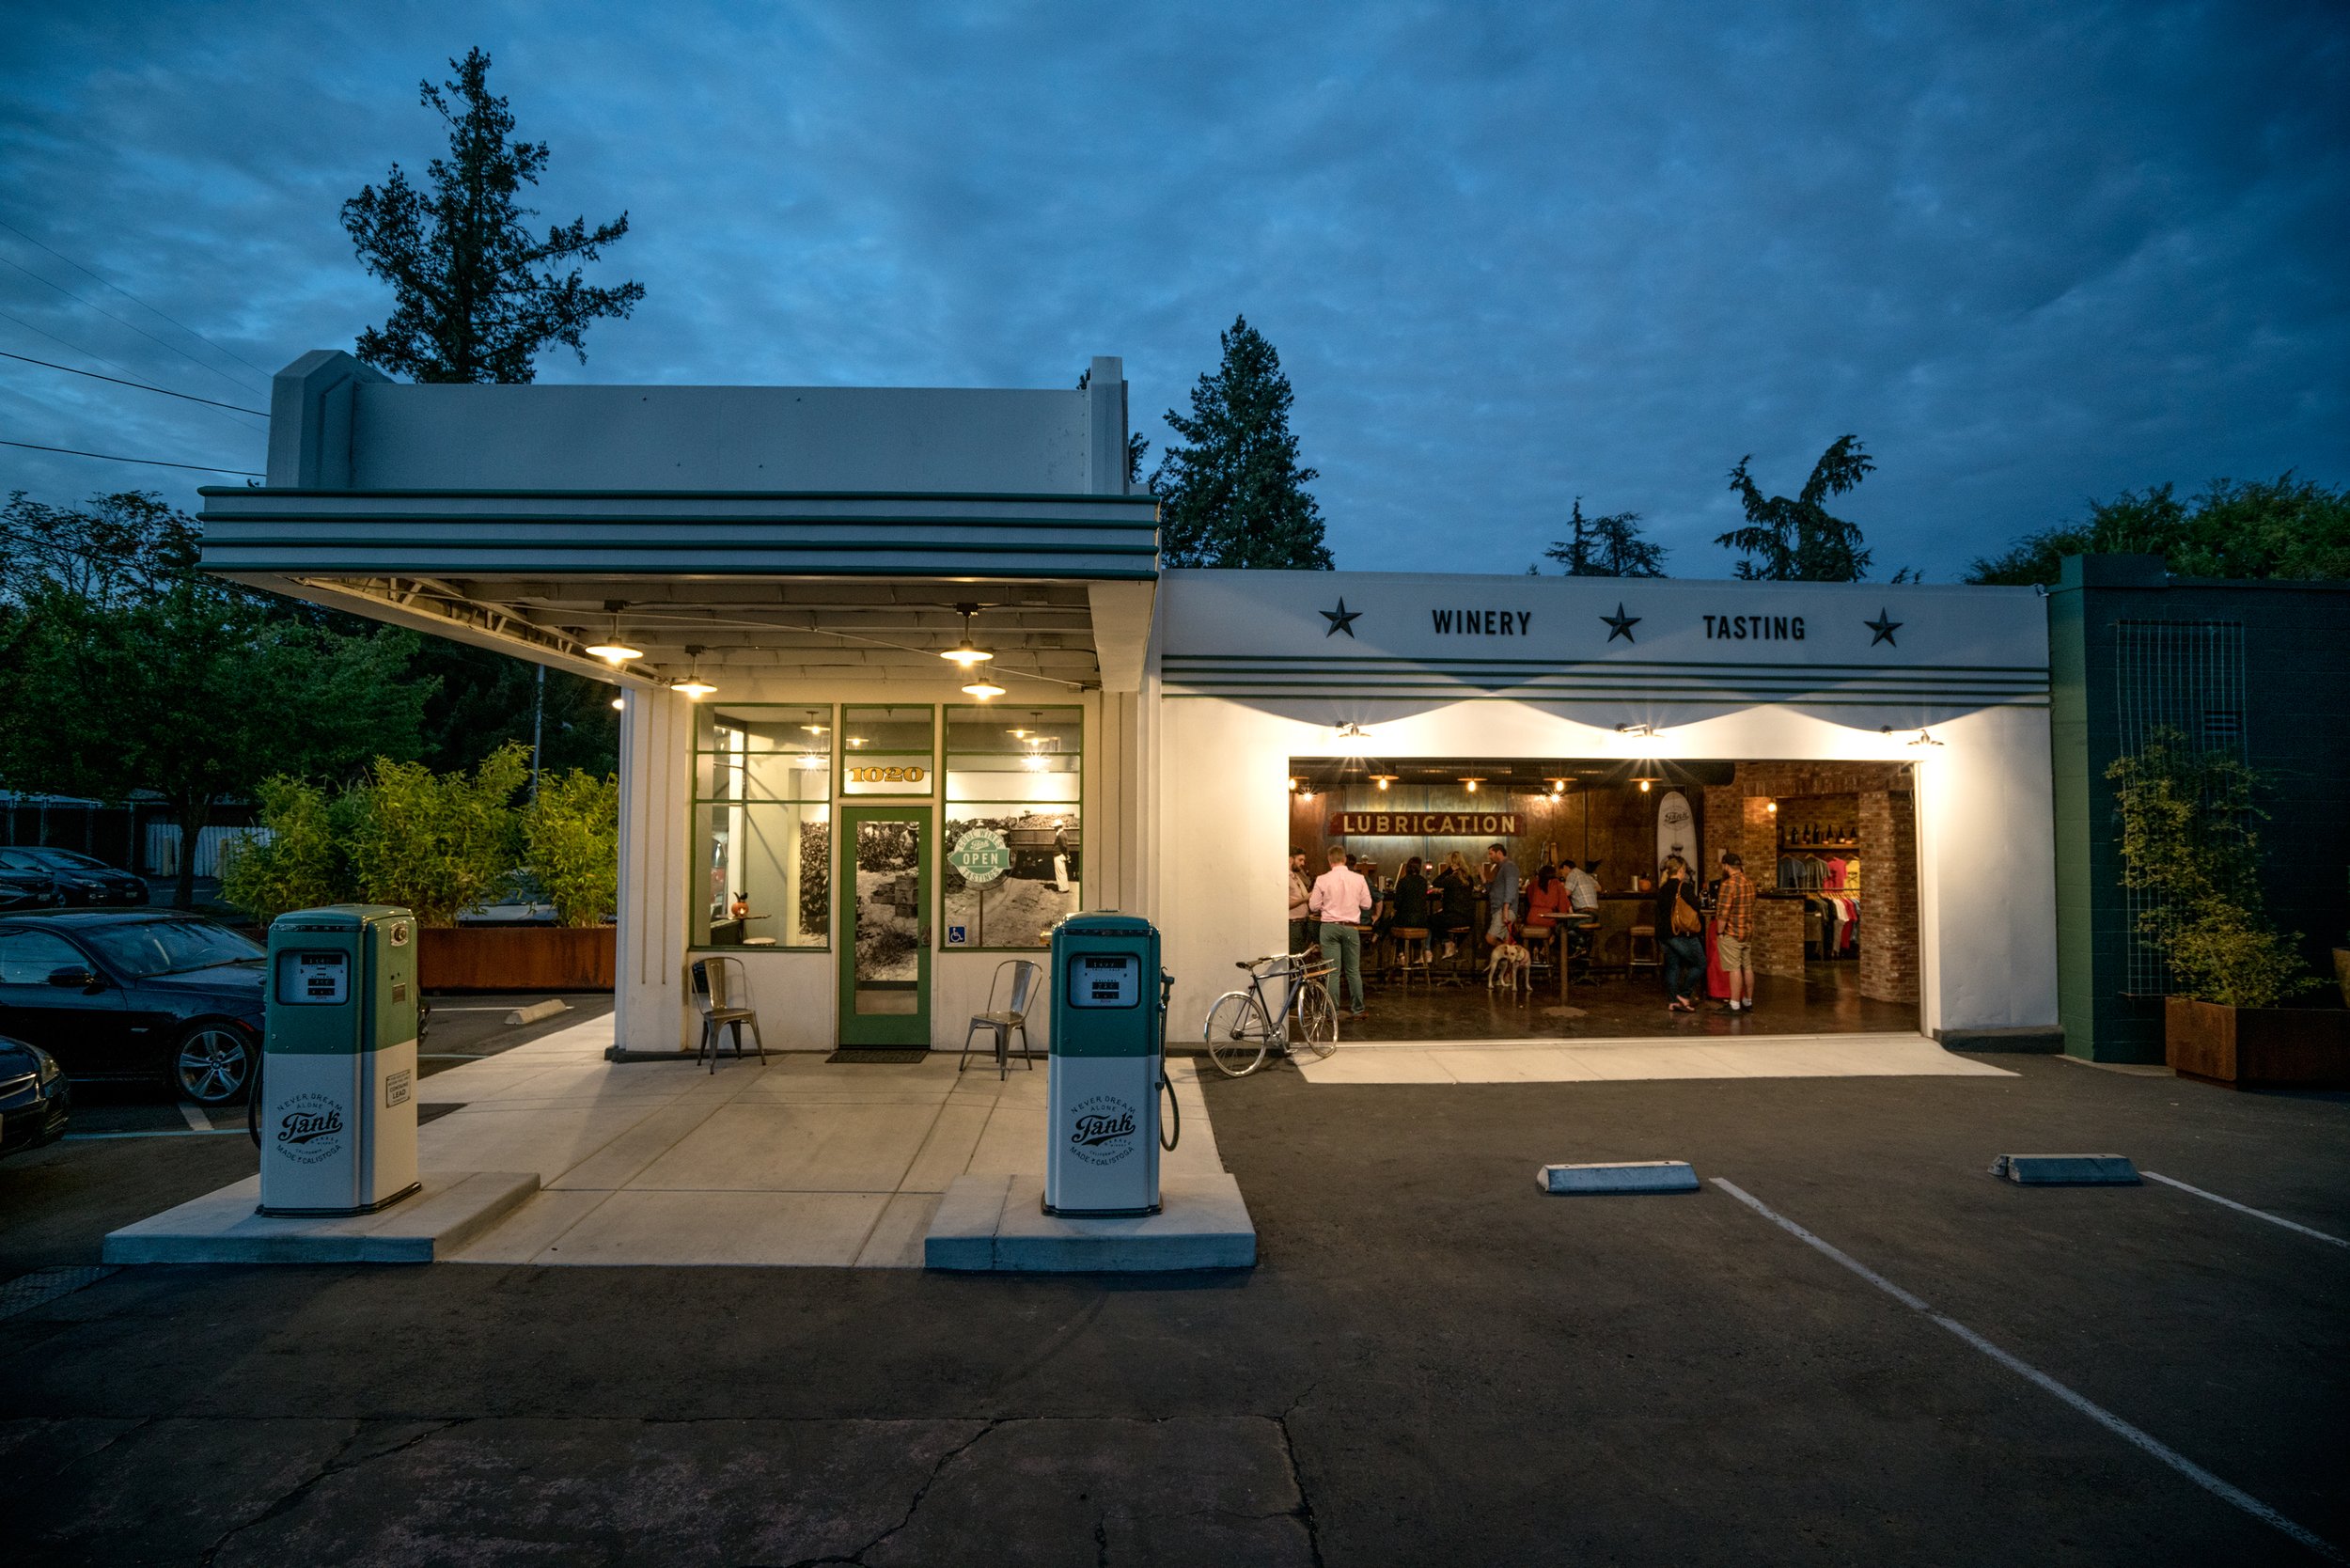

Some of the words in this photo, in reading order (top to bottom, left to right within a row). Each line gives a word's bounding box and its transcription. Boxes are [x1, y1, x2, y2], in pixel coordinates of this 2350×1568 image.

[1432, 610, 1531, 635] WINERY
[1702, 615, 1805, 639] TASTING
[850, 766, 924, 782] 1020
[1343, 815, 1515, 833] LUBRICATION
[957, 830, 977, 848] COOL
[979, 829, 1004, 847] WINES
[963, 853, 998, 865] OPEN
[963, 869, 999, 882] TASTINGS
[276, 1093, 308, 1111] NEVER
[310, 1093, 343, 1111] DREAM
[392, 1089, 406, 1099] LEAD
[1071, 1095, 1103, 1114] NEVER
[1104, 1095, 1136, 1114] DREAM
[278, 1109, 343, 1144] Tank
[1072, 1112, 1136, 1146] Tank
[276, 1144, 296, 1161] MADE
[302, 1145, 341, 1164] CALISTOGA
[1070, 1147, 1090, 1163] MADE
[1096, 1146, 1135, 1166] CALISTOGA
